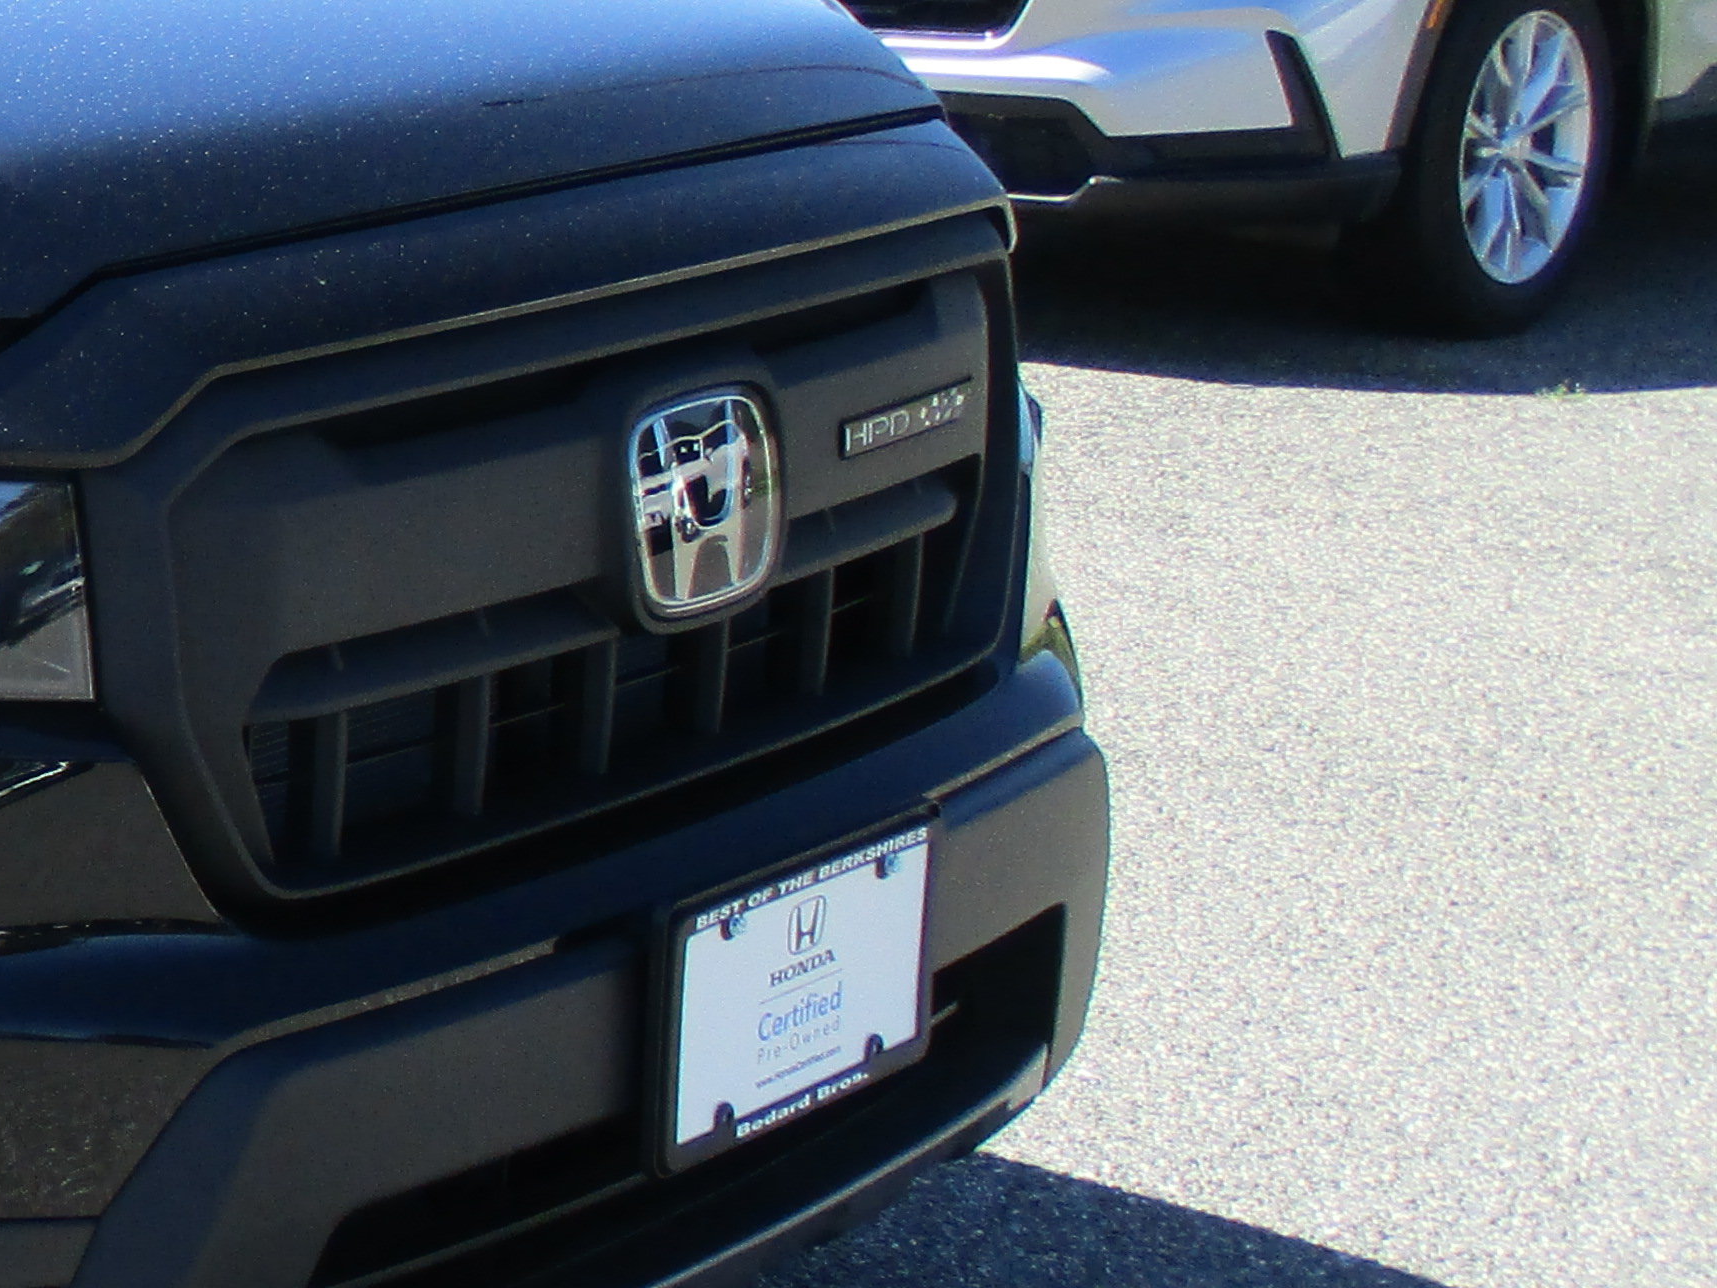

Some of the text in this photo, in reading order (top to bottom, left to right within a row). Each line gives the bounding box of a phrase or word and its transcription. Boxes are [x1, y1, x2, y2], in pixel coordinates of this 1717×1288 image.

[844, 409, 911, 452] HPD
[696, 827, 928, 929] BEST OF THE BERKSHIRES
[768, 948, 836, 987] HONDA
[757, 980, 843, 1042] Certified
[756, 1015, 841, 1065] Pre-Owned
[736, 1070, 869, 1138] Bedard Bros.
